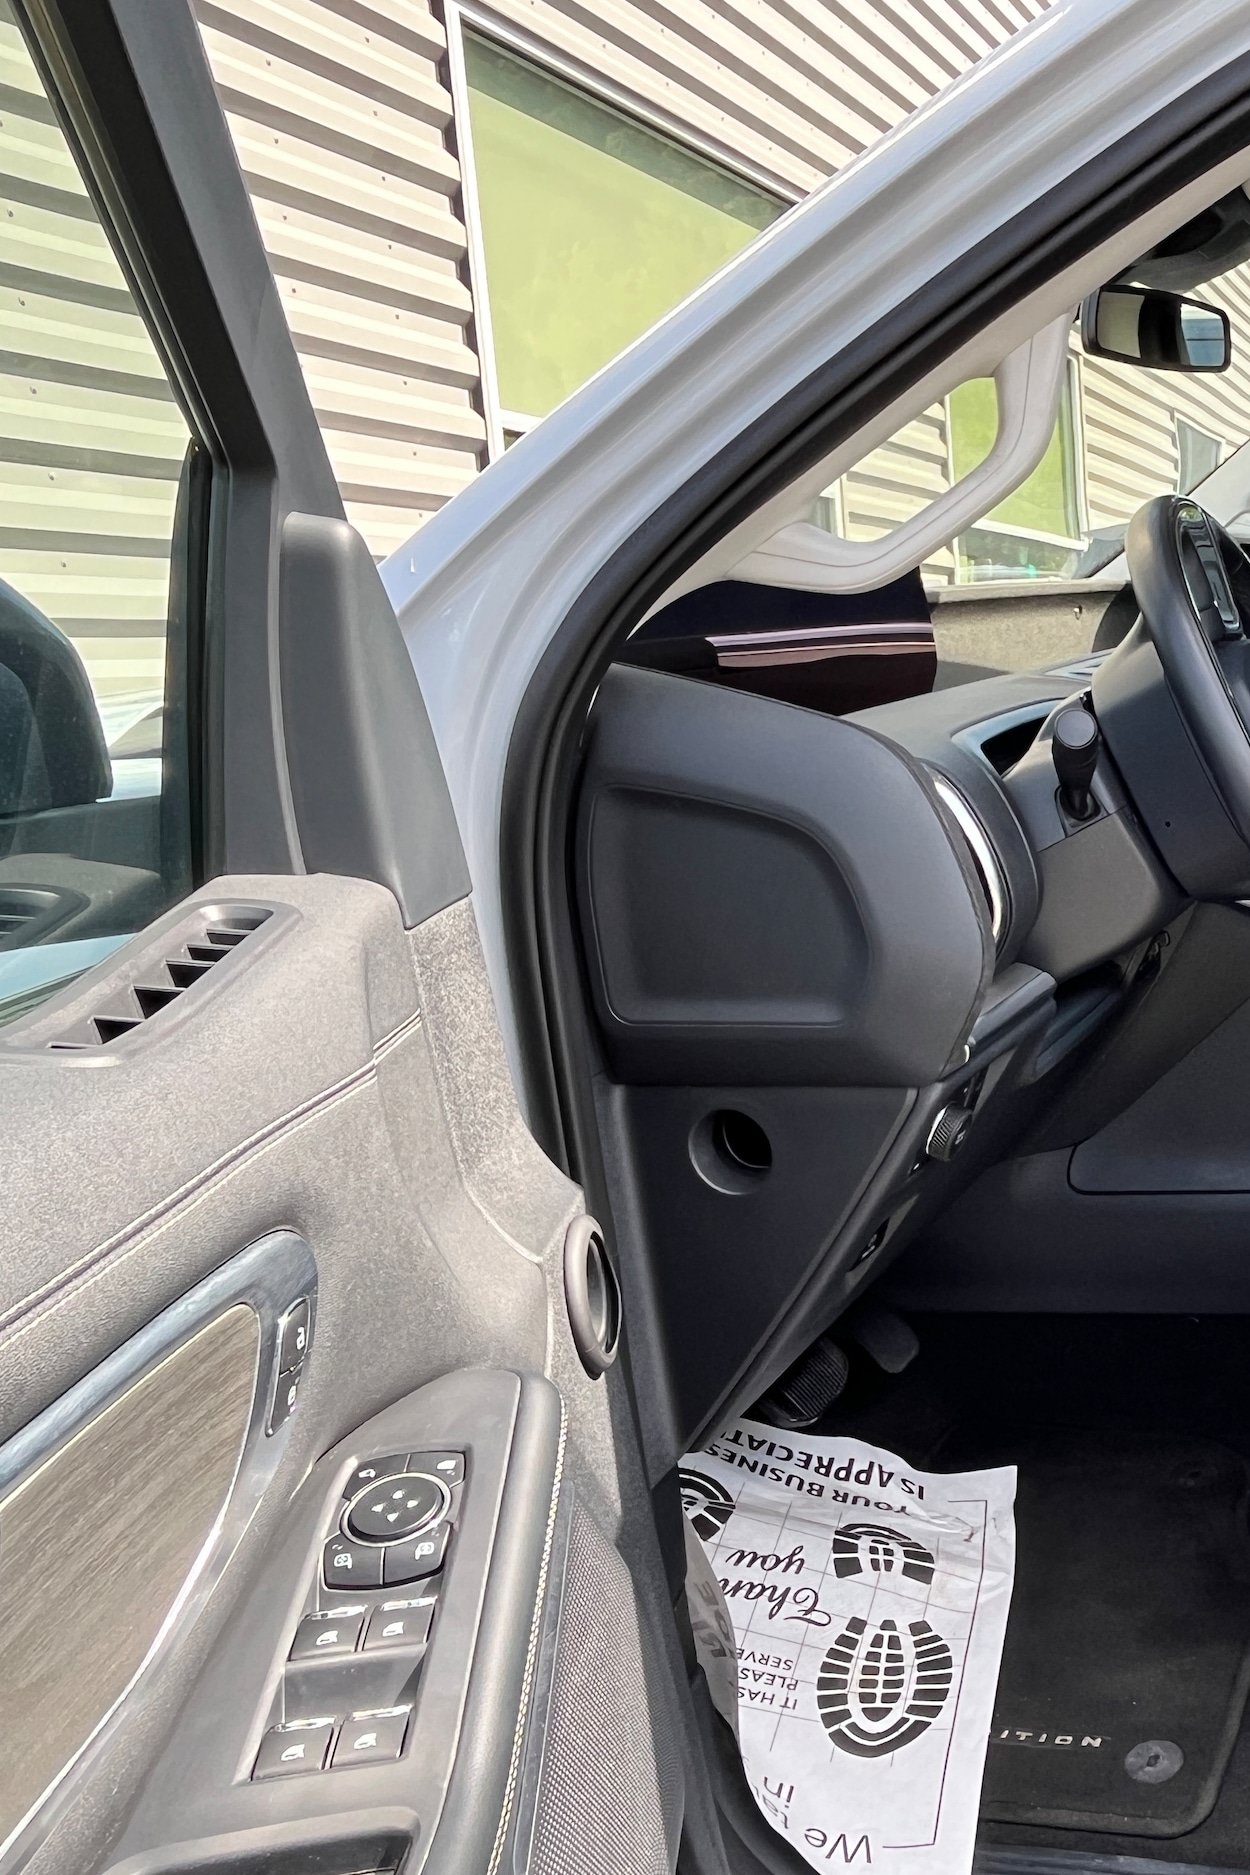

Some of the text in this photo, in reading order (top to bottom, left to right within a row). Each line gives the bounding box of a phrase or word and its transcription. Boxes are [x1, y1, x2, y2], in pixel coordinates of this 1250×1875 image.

[720, 1428, 925, 1500] IS APPRECIAT
[831, 1489, 912, 1516] YOUR
[725, 1545, 805, 1575] you
[737, 1686, 798, 1710] IT HAS
[763, 1776, 794, 1809] in
[804, 1828, 872, 1864] We
